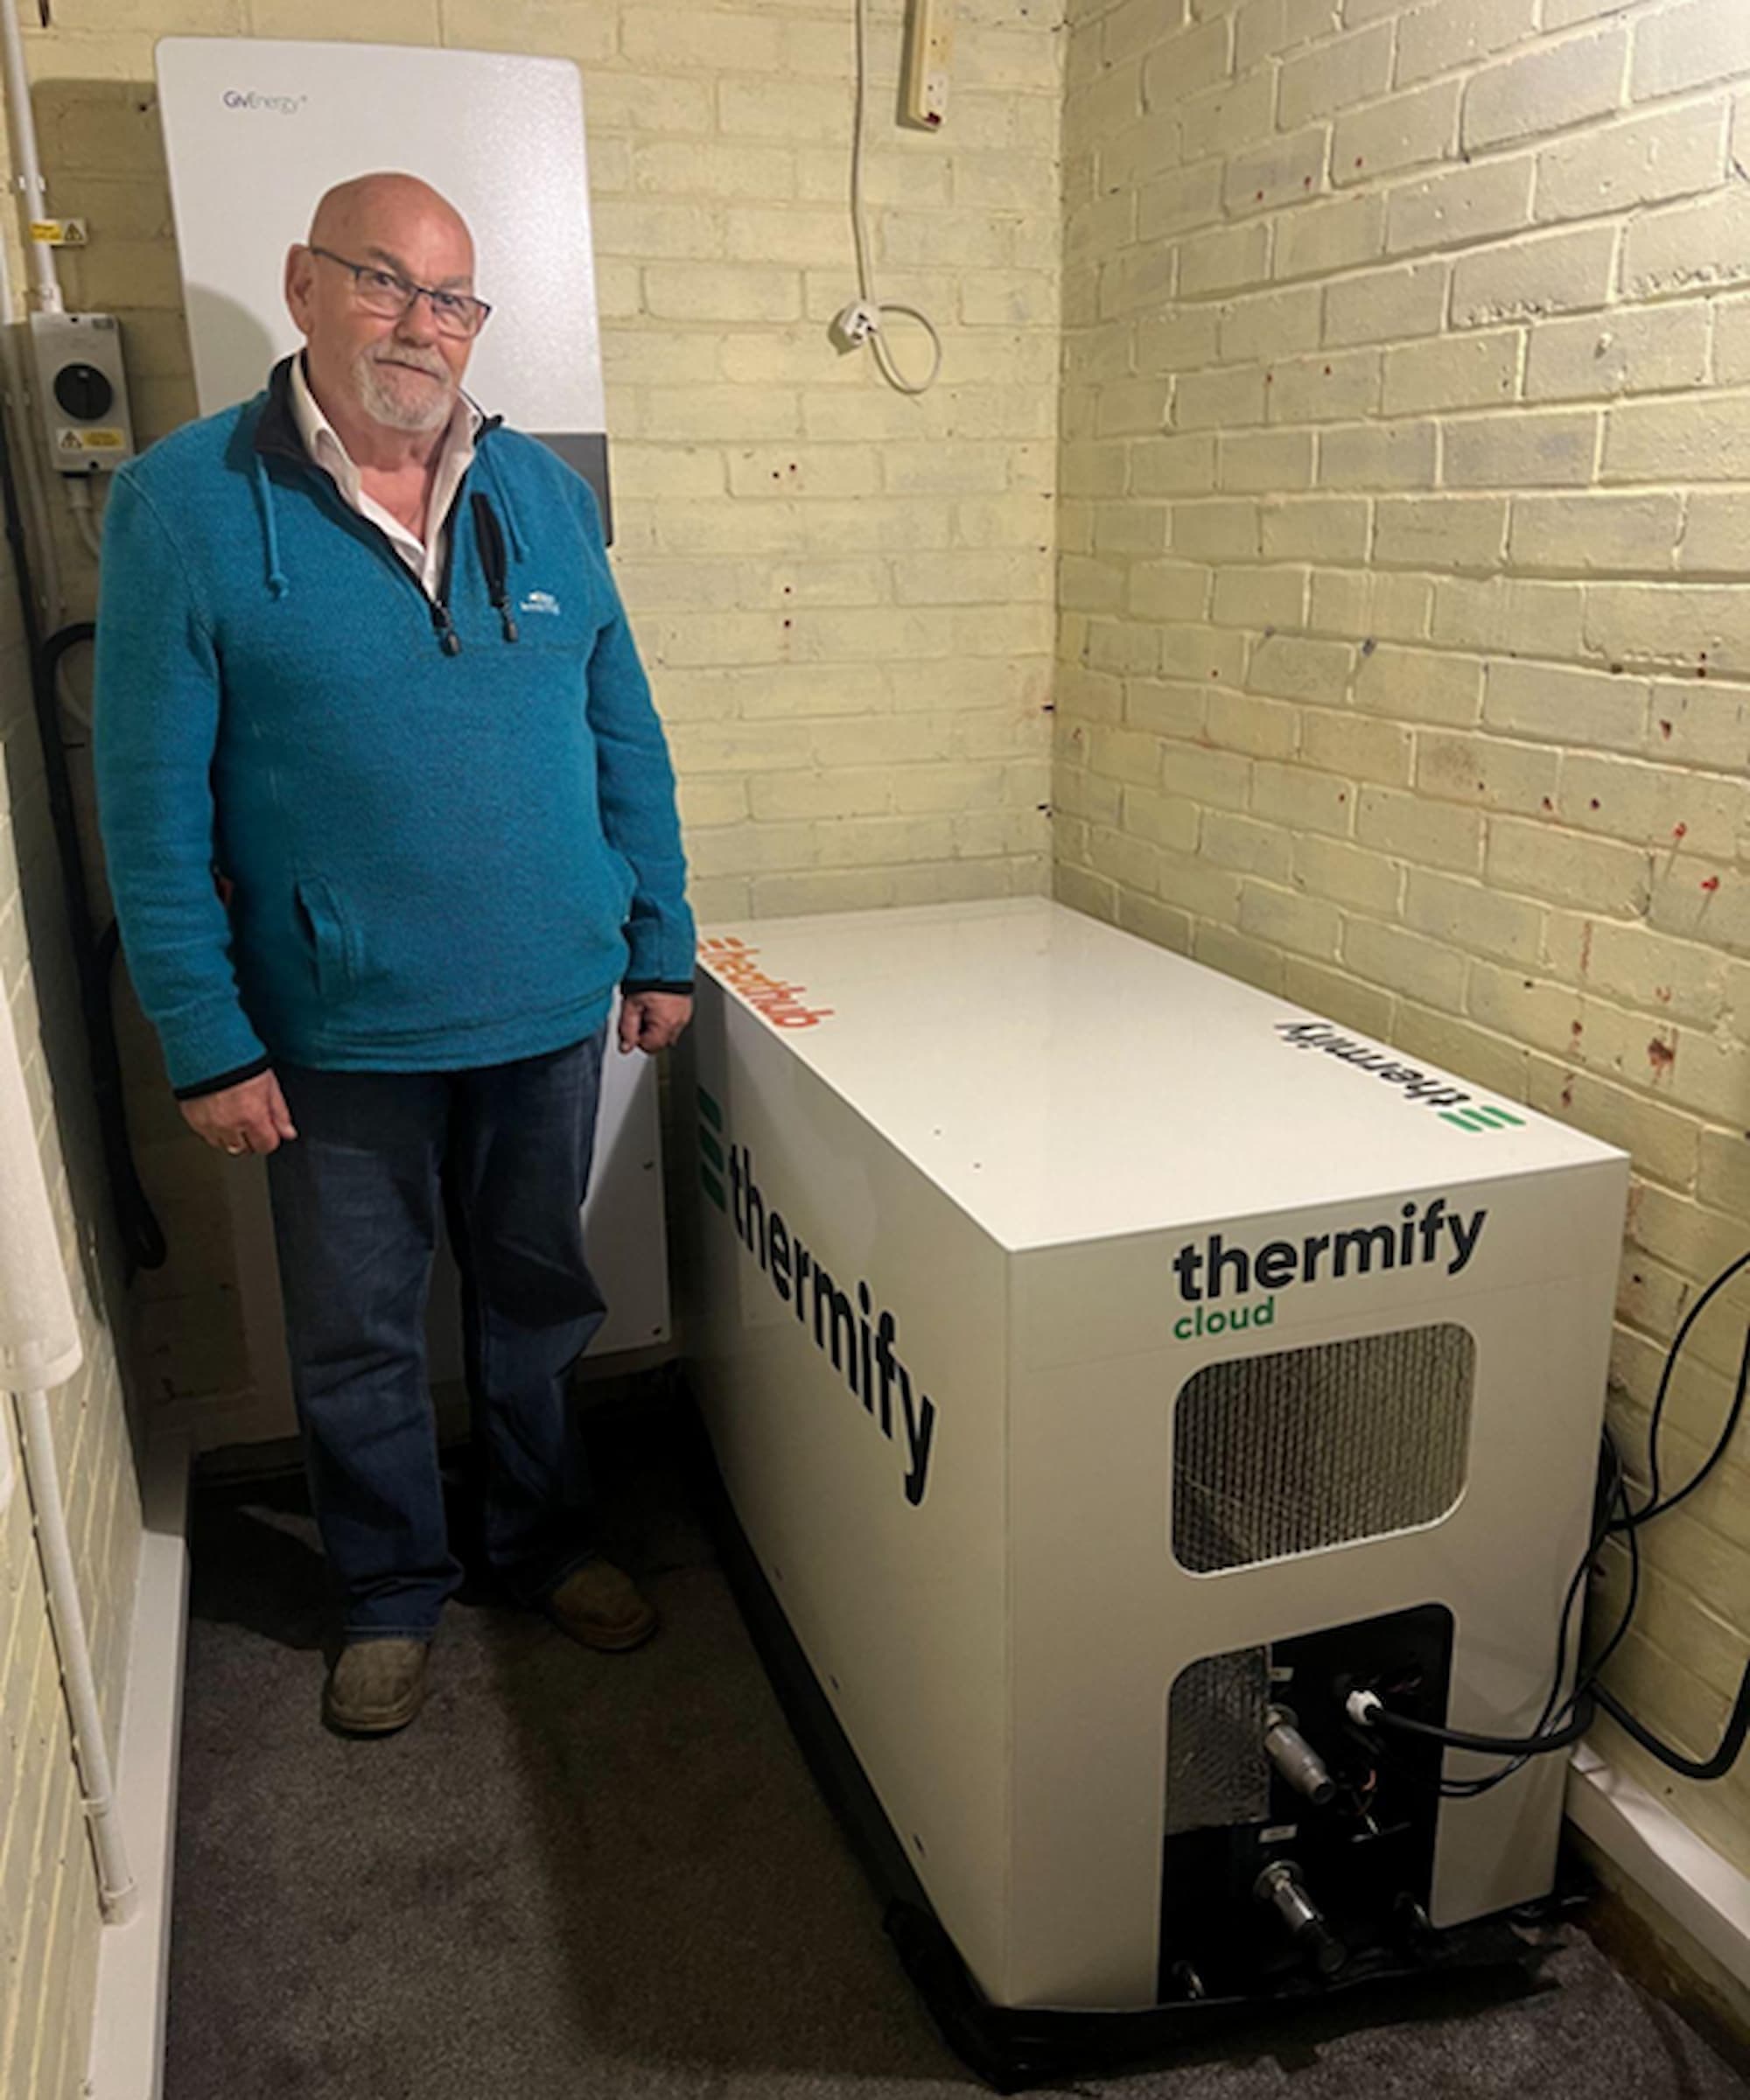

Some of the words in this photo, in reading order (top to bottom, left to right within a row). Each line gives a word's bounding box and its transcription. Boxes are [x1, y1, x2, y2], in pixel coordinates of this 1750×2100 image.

[702, 948, 834, 1028] heathub
[1274, 1023, 1472, 1106] thermify
[1173, 1199, 1487, 1301] thermify
[729, 1144, 935, 1506] thermify
[1173, 1295, 1274, 1340] cloud
